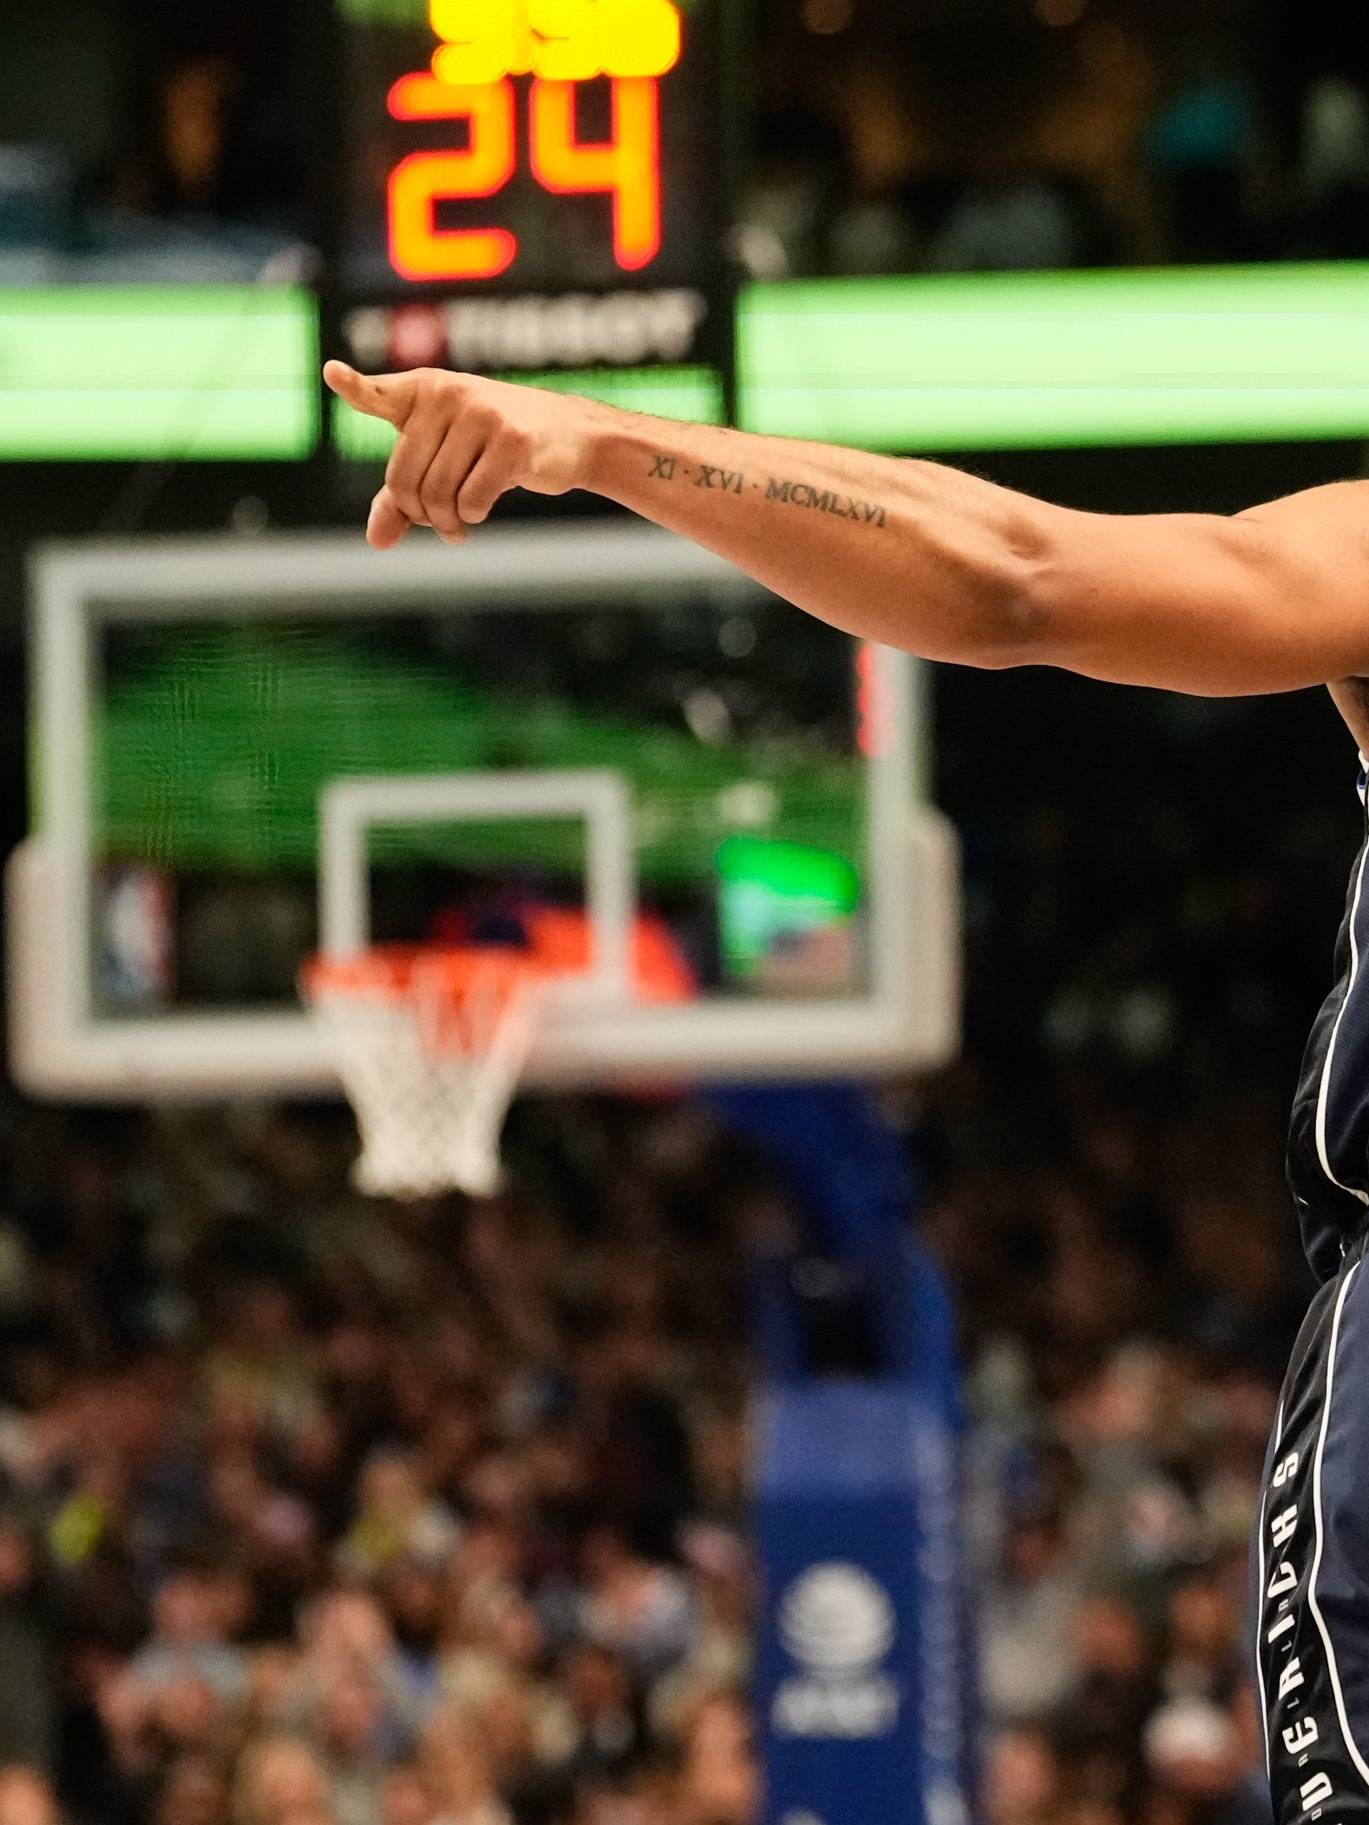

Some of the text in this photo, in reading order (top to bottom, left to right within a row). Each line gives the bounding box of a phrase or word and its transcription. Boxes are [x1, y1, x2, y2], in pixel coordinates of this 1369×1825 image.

[387, 72, 661, 282] 24
[648, 455, 886, 528] XI XVI MCMLXVI
